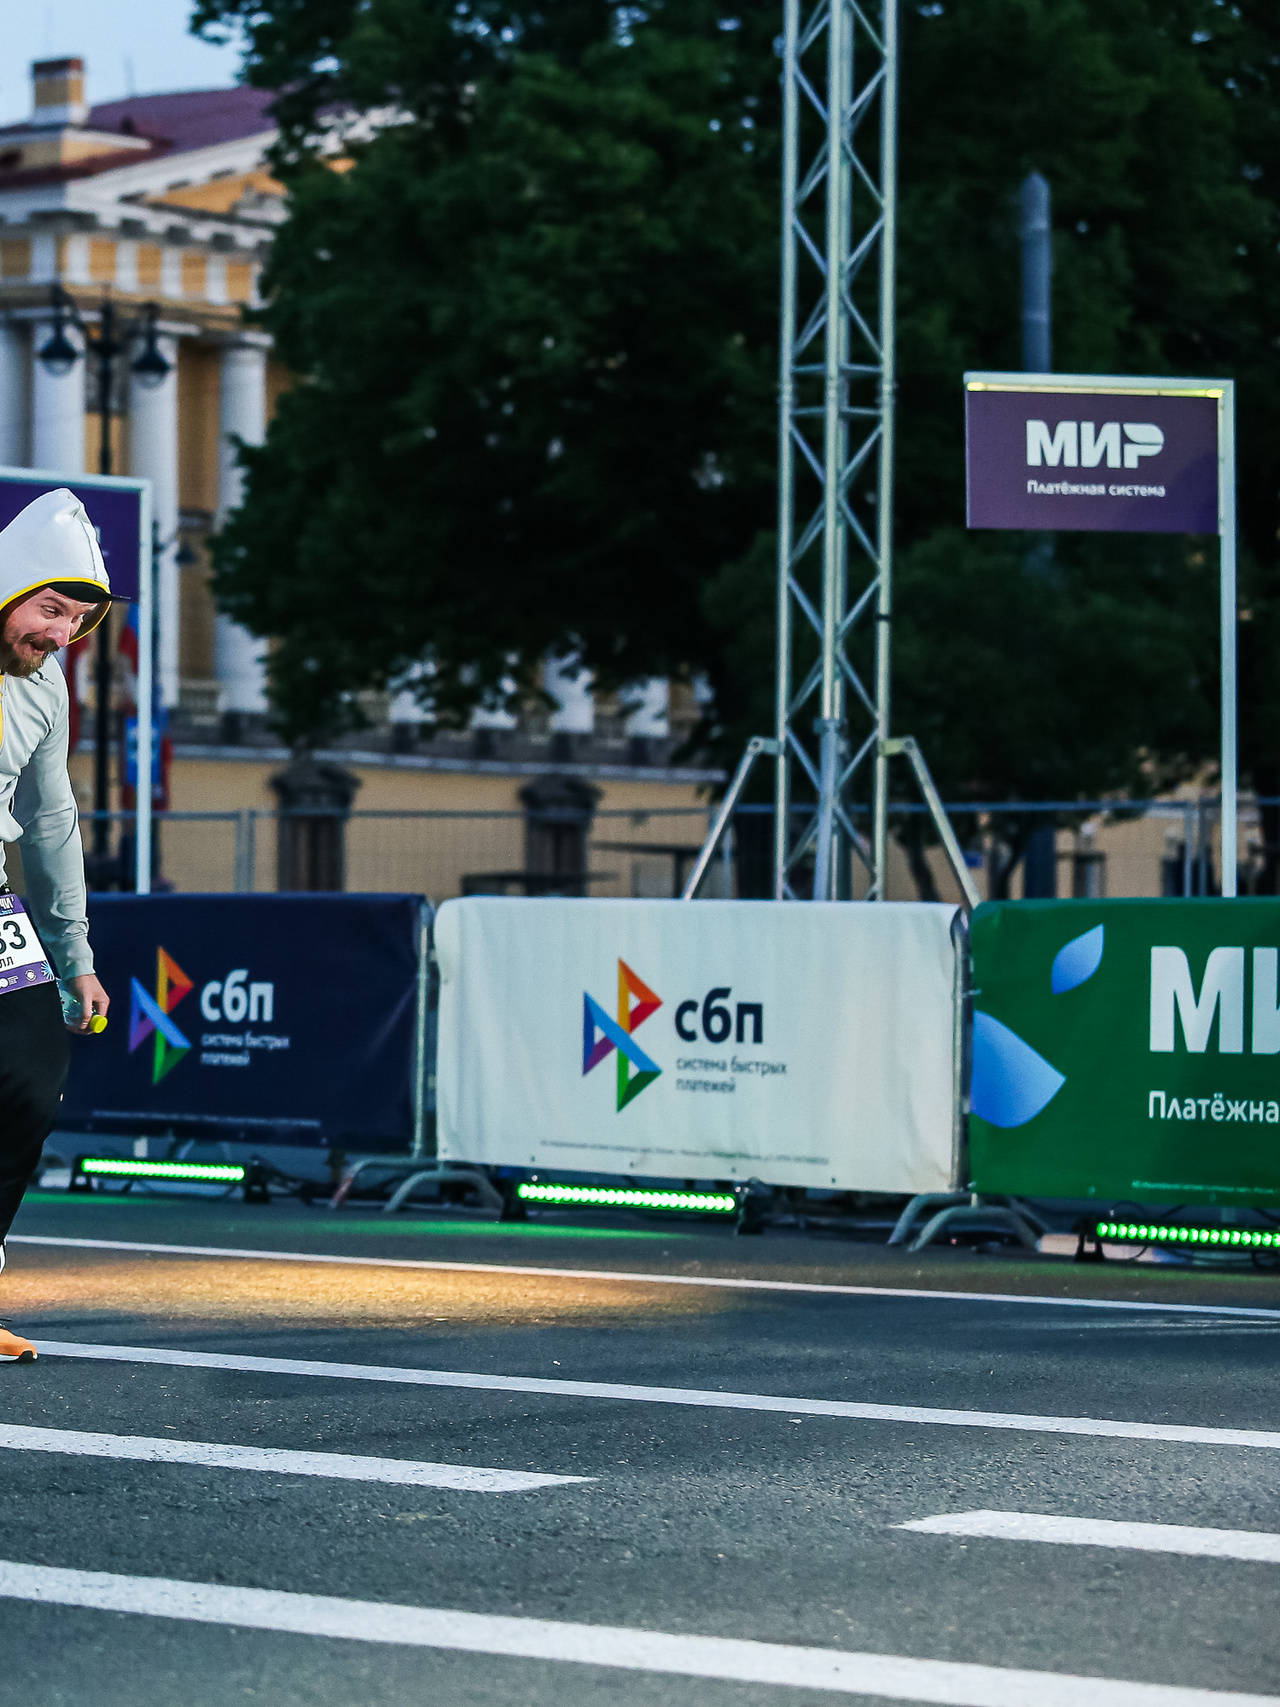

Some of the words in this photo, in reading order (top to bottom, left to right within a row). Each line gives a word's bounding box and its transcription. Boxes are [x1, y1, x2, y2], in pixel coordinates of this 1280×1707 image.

[1026, 419, 1164, 468] МИР
[1108, 484, 1166, 497] система
[201, 968, 274, 1022] сбп
[675, 987, 763, 1044] сбп
[677, 1058, 727, 1072] система
[730, 1055, 787, 1077] быстрых
[1148, 1090, 1280, 1123] Платёжна
